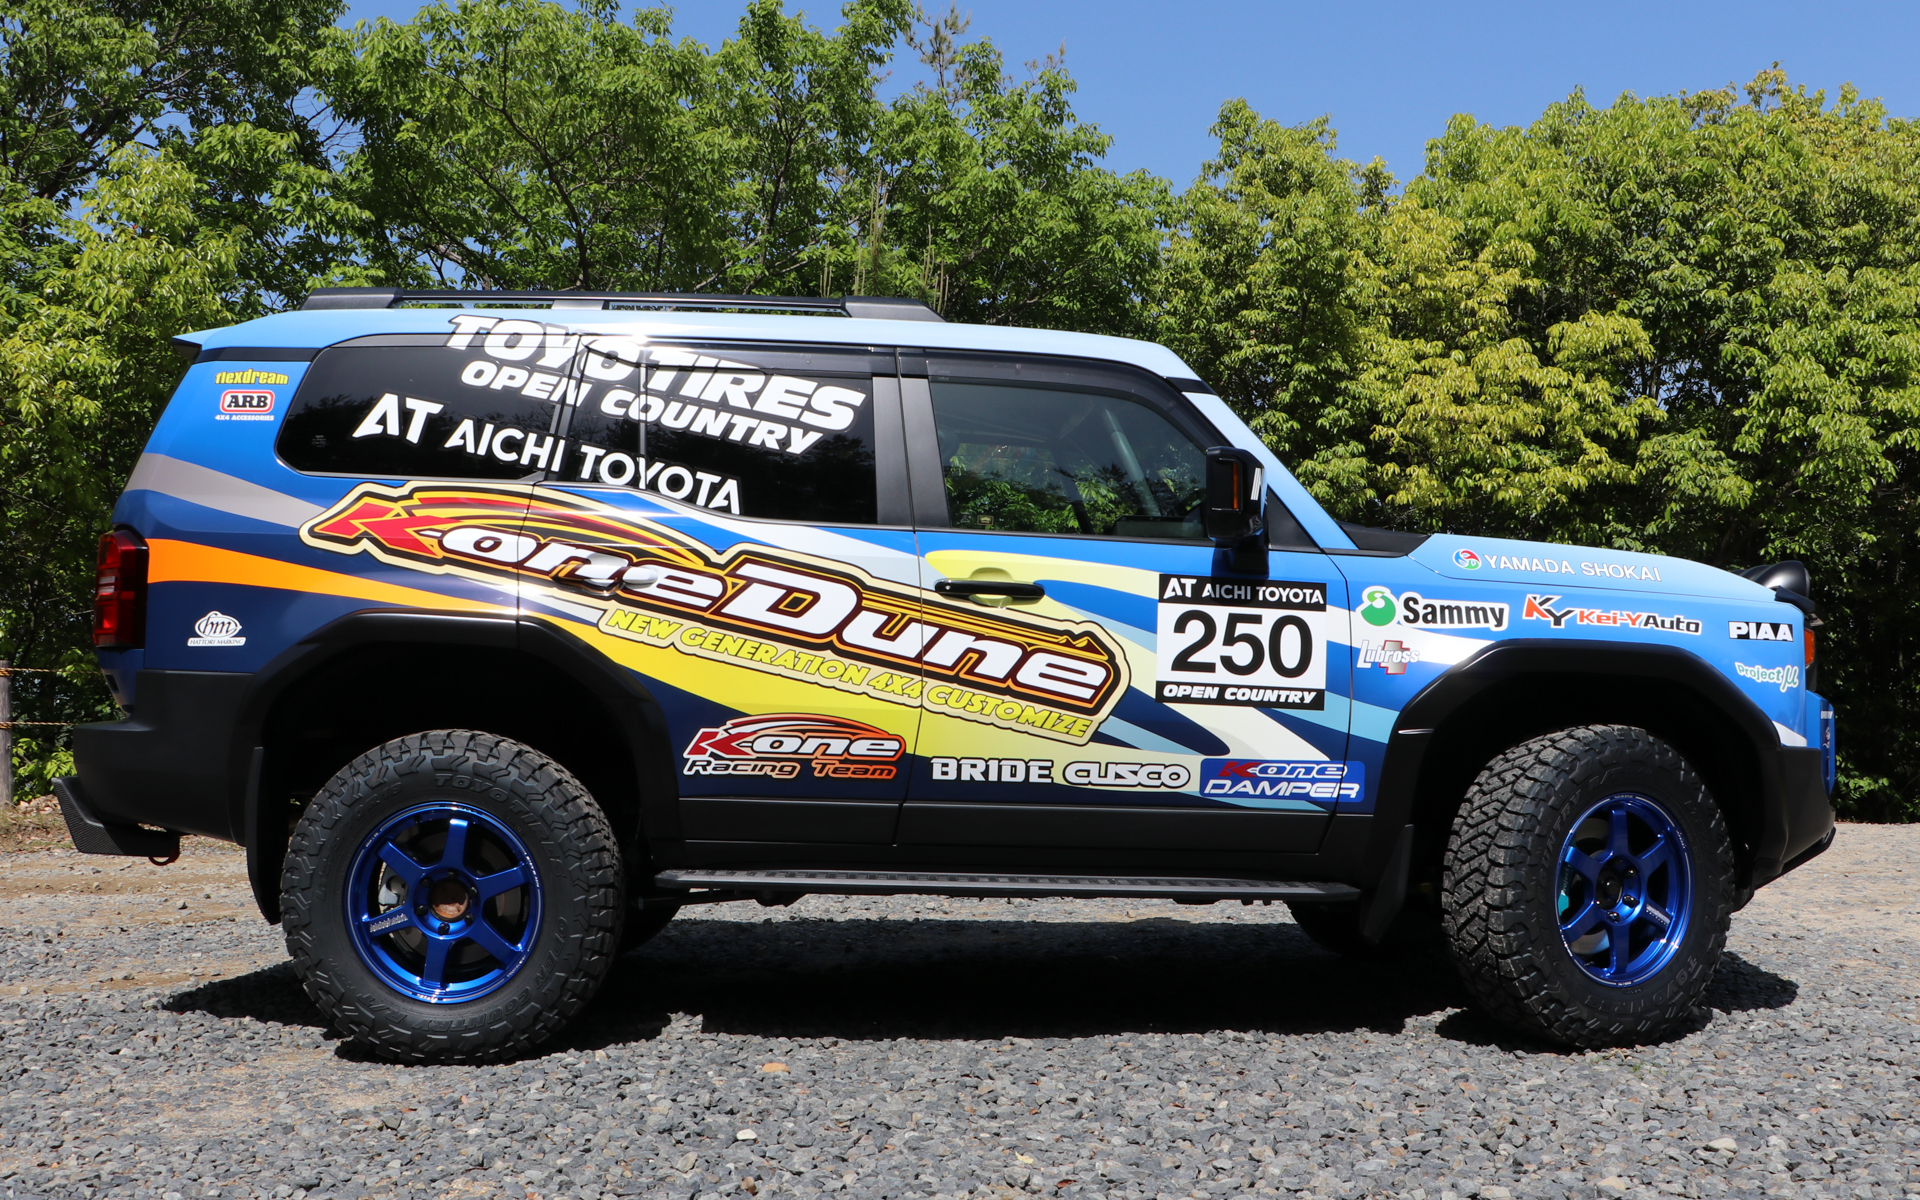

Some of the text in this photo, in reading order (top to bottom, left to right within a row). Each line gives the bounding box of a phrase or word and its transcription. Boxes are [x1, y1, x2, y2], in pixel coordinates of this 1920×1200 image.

[215, 368, 289, 385] flexdream
[446, 314, 867, 431] TOYO TIRES
[226, 394, 269, 408] ARB
[460, 361, 822, 455] OPEN COUNTRY
[353, 393, 740, 515] AT AICHI TOYOTA
[1484, 553, 1662, 582] YAMADA SHOKAI
[1162, 577, 1325, 605] AT AICHI TOYOTA
[1402, 595, 1505, 628] Sammy
[1171, 609, 1313, 679] 250
[1729, 621, 1794, 642] PIAA
[1356, 639, 1420, 669] Lubross
[605, 608, 1094, 739] NEW GENERATION 4X4 CUSTOMIZE
[1162, 684, 1318, 704] OPEN COUNTRY
[685, 758, 897, 778] Racing Team
[930, 757, 1053, 783] BRIDE
[1064, 761, 1189, 787] CUSCO
[433, 773, 509, 803] TOYO
[1203, 778, 1360, 799] DAMPER
